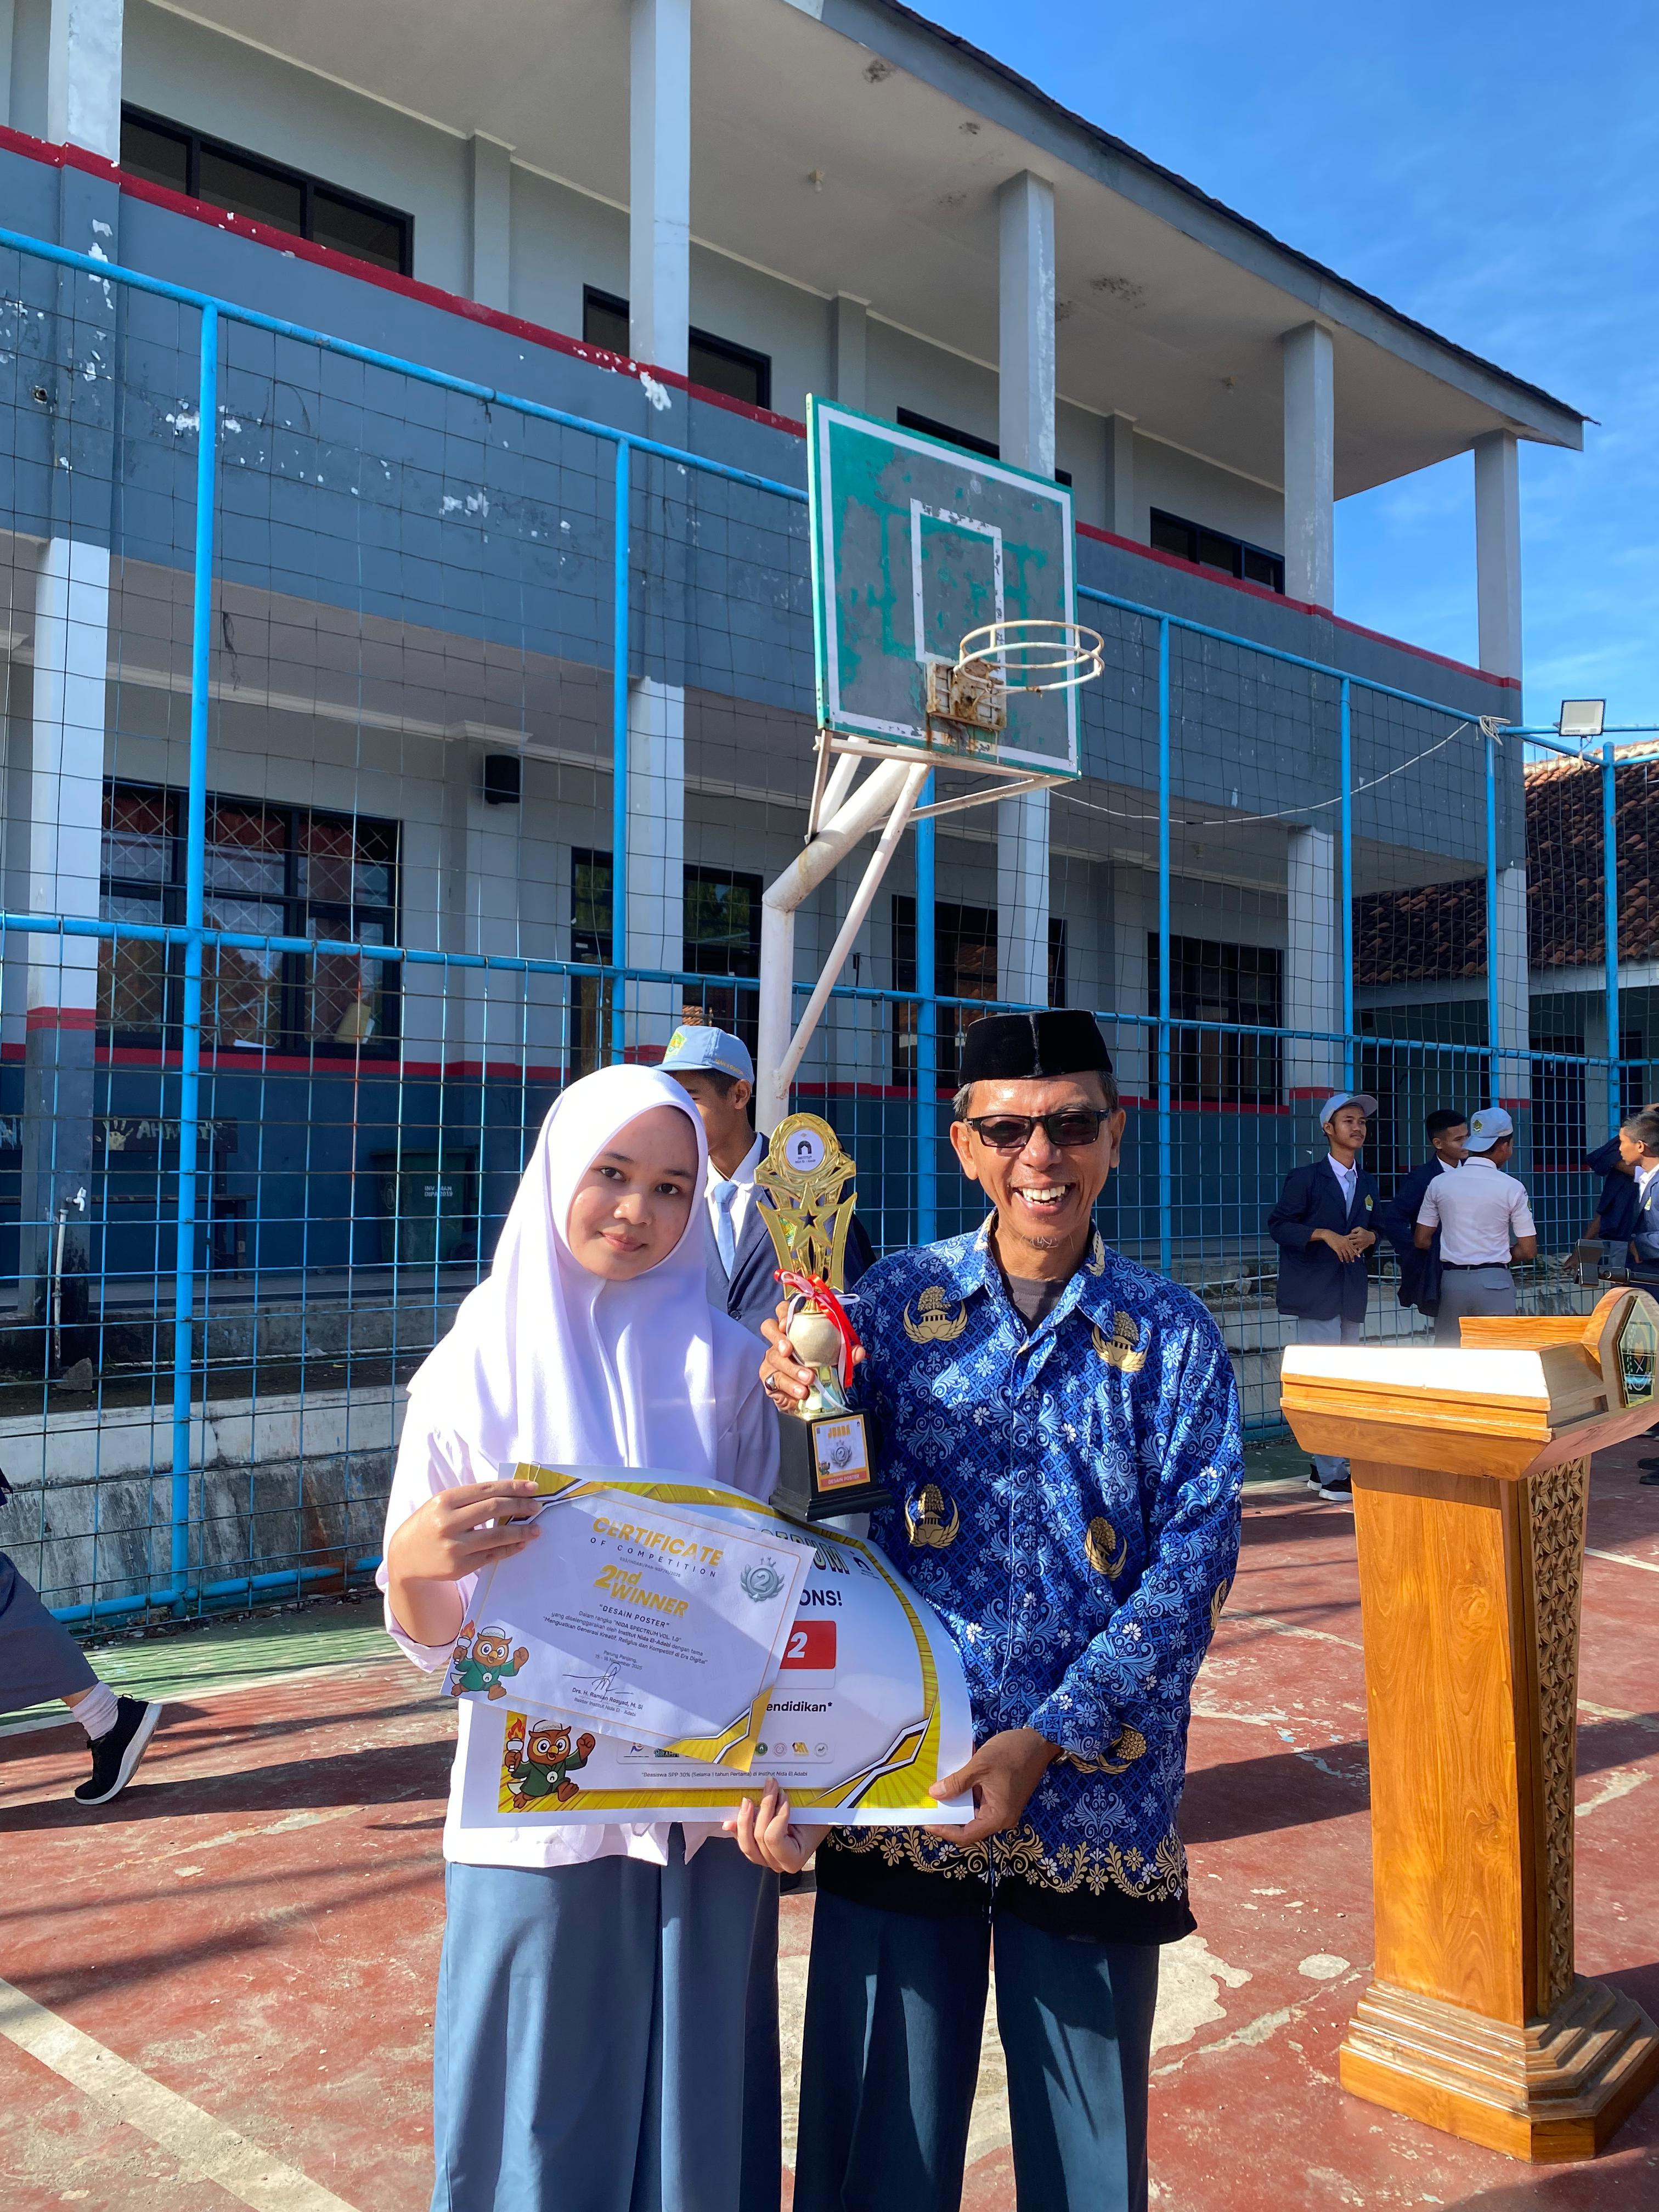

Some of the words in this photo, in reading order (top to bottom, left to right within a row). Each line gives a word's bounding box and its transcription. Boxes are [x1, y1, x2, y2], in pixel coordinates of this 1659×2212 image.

[592, 1517, 724, 1567] CERTIFICATE
[590, 1537, 606, 1546] OF
[617, 1545, 716, 1577] COMPETITION
[594, 1564, 642, 1589] 2nd
[754, 1571, 771, 1592] 2
[610, 1582, 689, 1617] WINNER
[565, 1615, 605, 1629] diselenggarakan
[618, 1629, 636, 1638] Institut
[672, 1644, 690, 1652] dengan
[579, 1611, 594, 1620] Dalam
[595, 1616, 612, 1624] rangka
[630, 1624, 659, 1635] SPECTRUM
[577, 1626, 599, 1635] Generasi
[618, 1637, 637, 1646] Religius
[649, 1645, 674, 1656] Kompetitif
[787, 1632, 808, 1658] 2
[603, 1650, 618, 1659] Parung
[609, 1697, 629, 1707] Rosyad,
